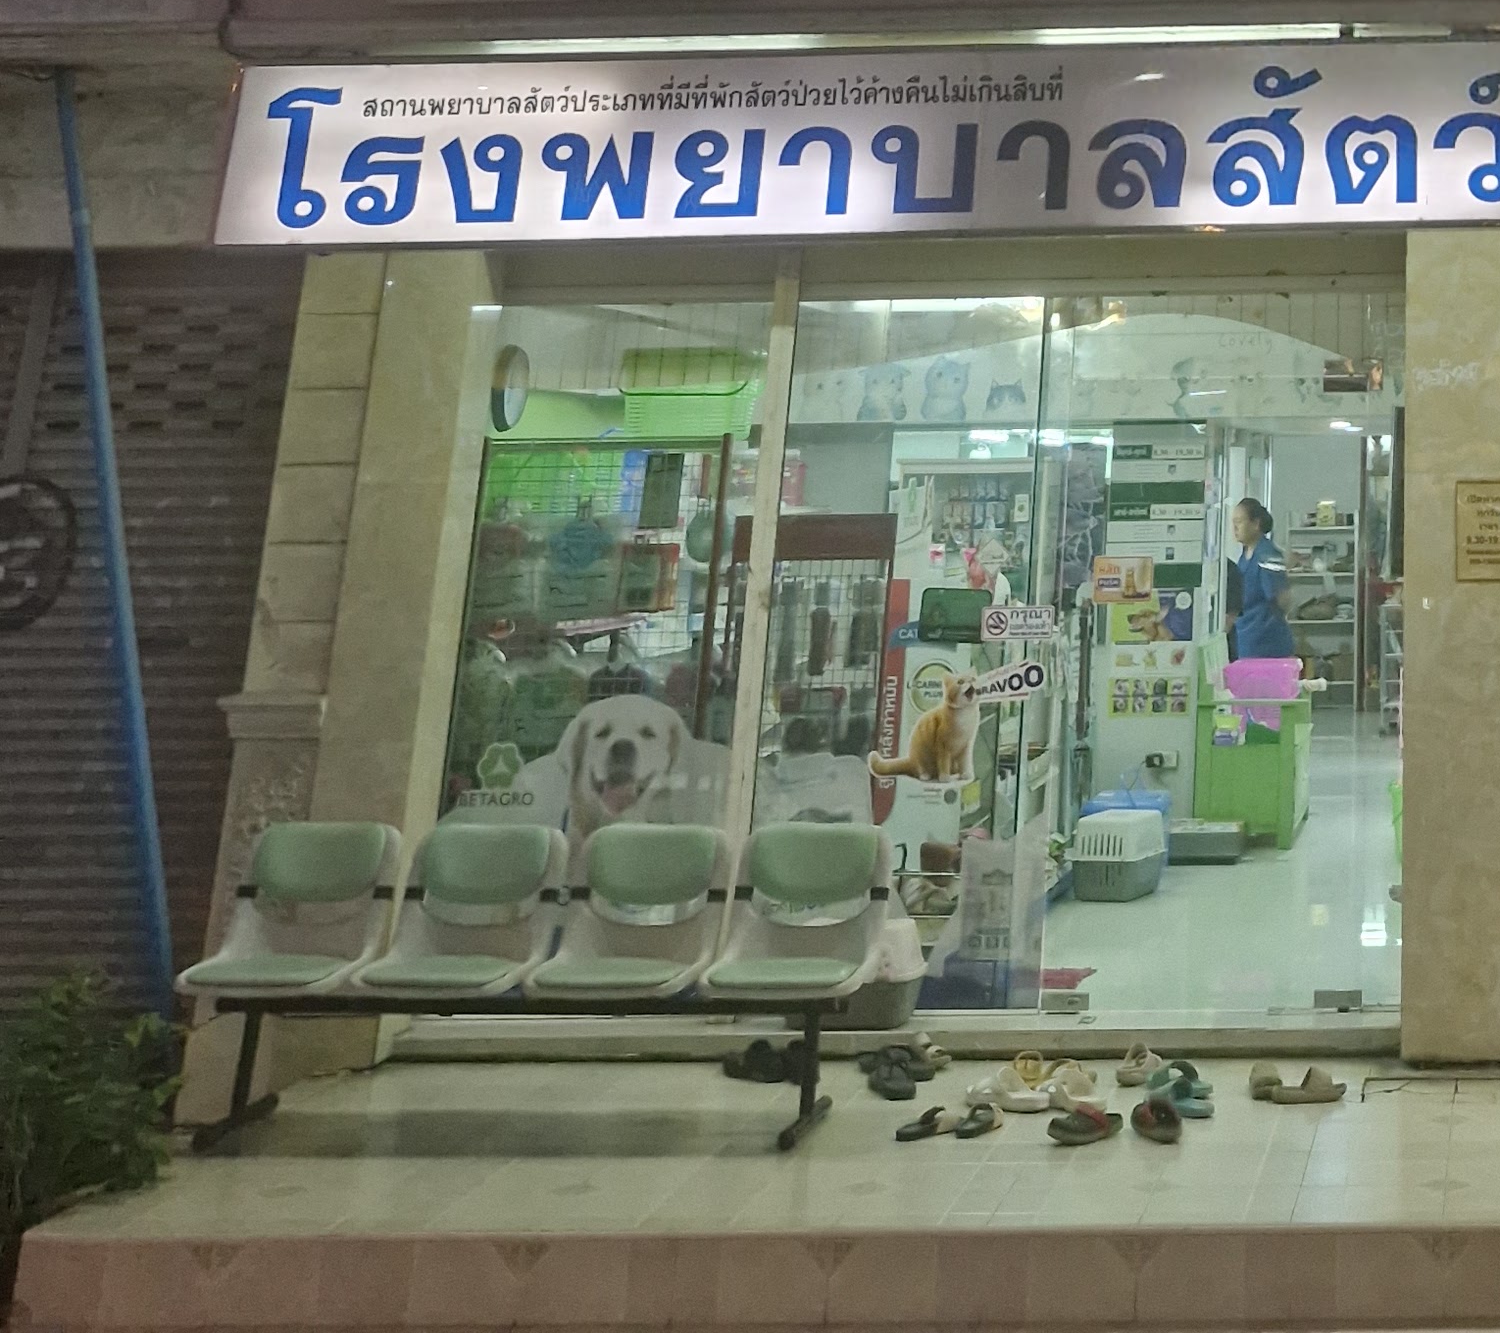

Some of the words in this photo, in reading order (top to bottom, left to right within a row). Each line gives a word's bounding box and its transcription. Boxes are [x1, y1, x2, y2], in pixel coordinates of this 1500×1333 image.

[362, 65, 1064, 118] สถานพยาบาลสัตว์ประเภทที่มีที่พักสัตว์ป่วยไว้ค้างคืนไม่เกินสิบที่
[1010, 609, 1051, 623] กรุณา
